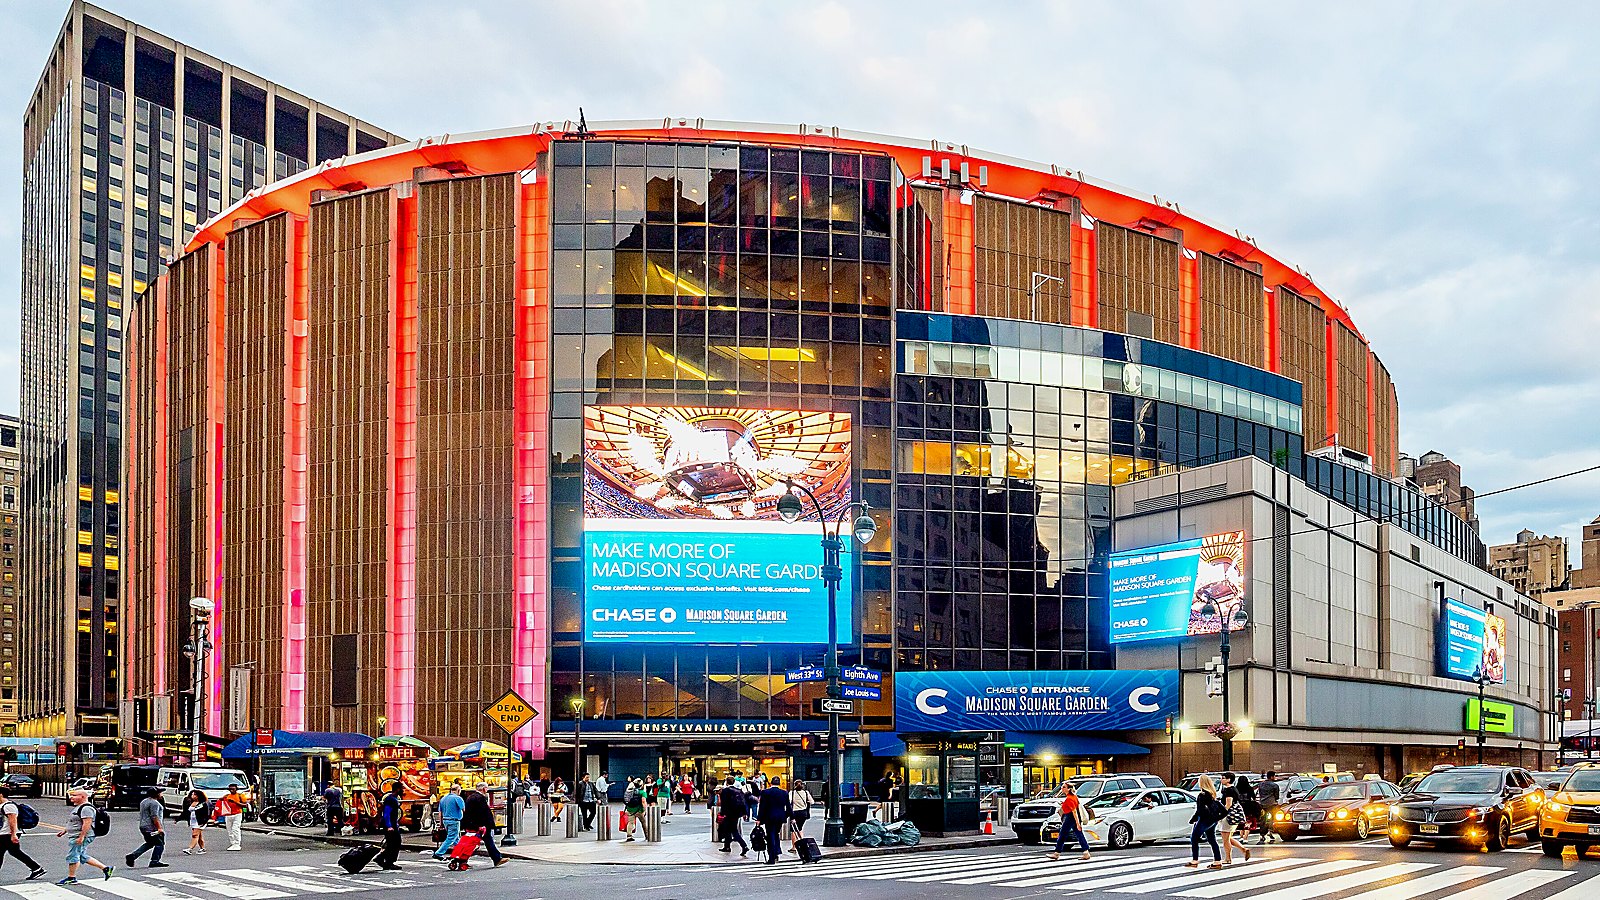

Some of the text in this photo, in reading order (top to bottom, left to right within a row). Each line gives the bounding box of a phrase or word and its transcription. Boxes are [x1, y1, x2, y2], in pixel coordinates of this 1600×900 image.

[592, 542, 736, 559] MAKE MORE OF
[592, 562, 825, 581] MADISON SQUARE GARDE
[1113, 573, 1157, 586] MAKE MORE OF
[1113, 576, 1191, 592] MADISON SQUARE GARDEN
[613, 584, 650, 592] cardholders
[592, 608, 657, 622] CHASE
[685, 608, 722, 620] MADISON
[723, 608, 754, 621] SQUARE
[1113, 619, 1139, 629] CHASE
[788, 669, 823, 680] West 33rd St
[844, 669, 879, 680] Eighth Ave
[844, 688, 854, 696] Joe
[855, 688, 869, 697] Louis
[1031, 686, 1091, 694] ENTRANCE
[915, 688, 949, 715] C
[965, 696, 1016, 712] MADISON
[1019, 695, 1062, 711] SQUARE
[1128, 686, 1161, 713] C
[497, 704, 524, 712] DEAD
[500, 714, 521, 722] END
[625, 723, 788, 732] PENNSYLVANIA STATION
[344, 749, 364, 758] HOT DOG
[379, 748, 417, 759] ALAFEL
